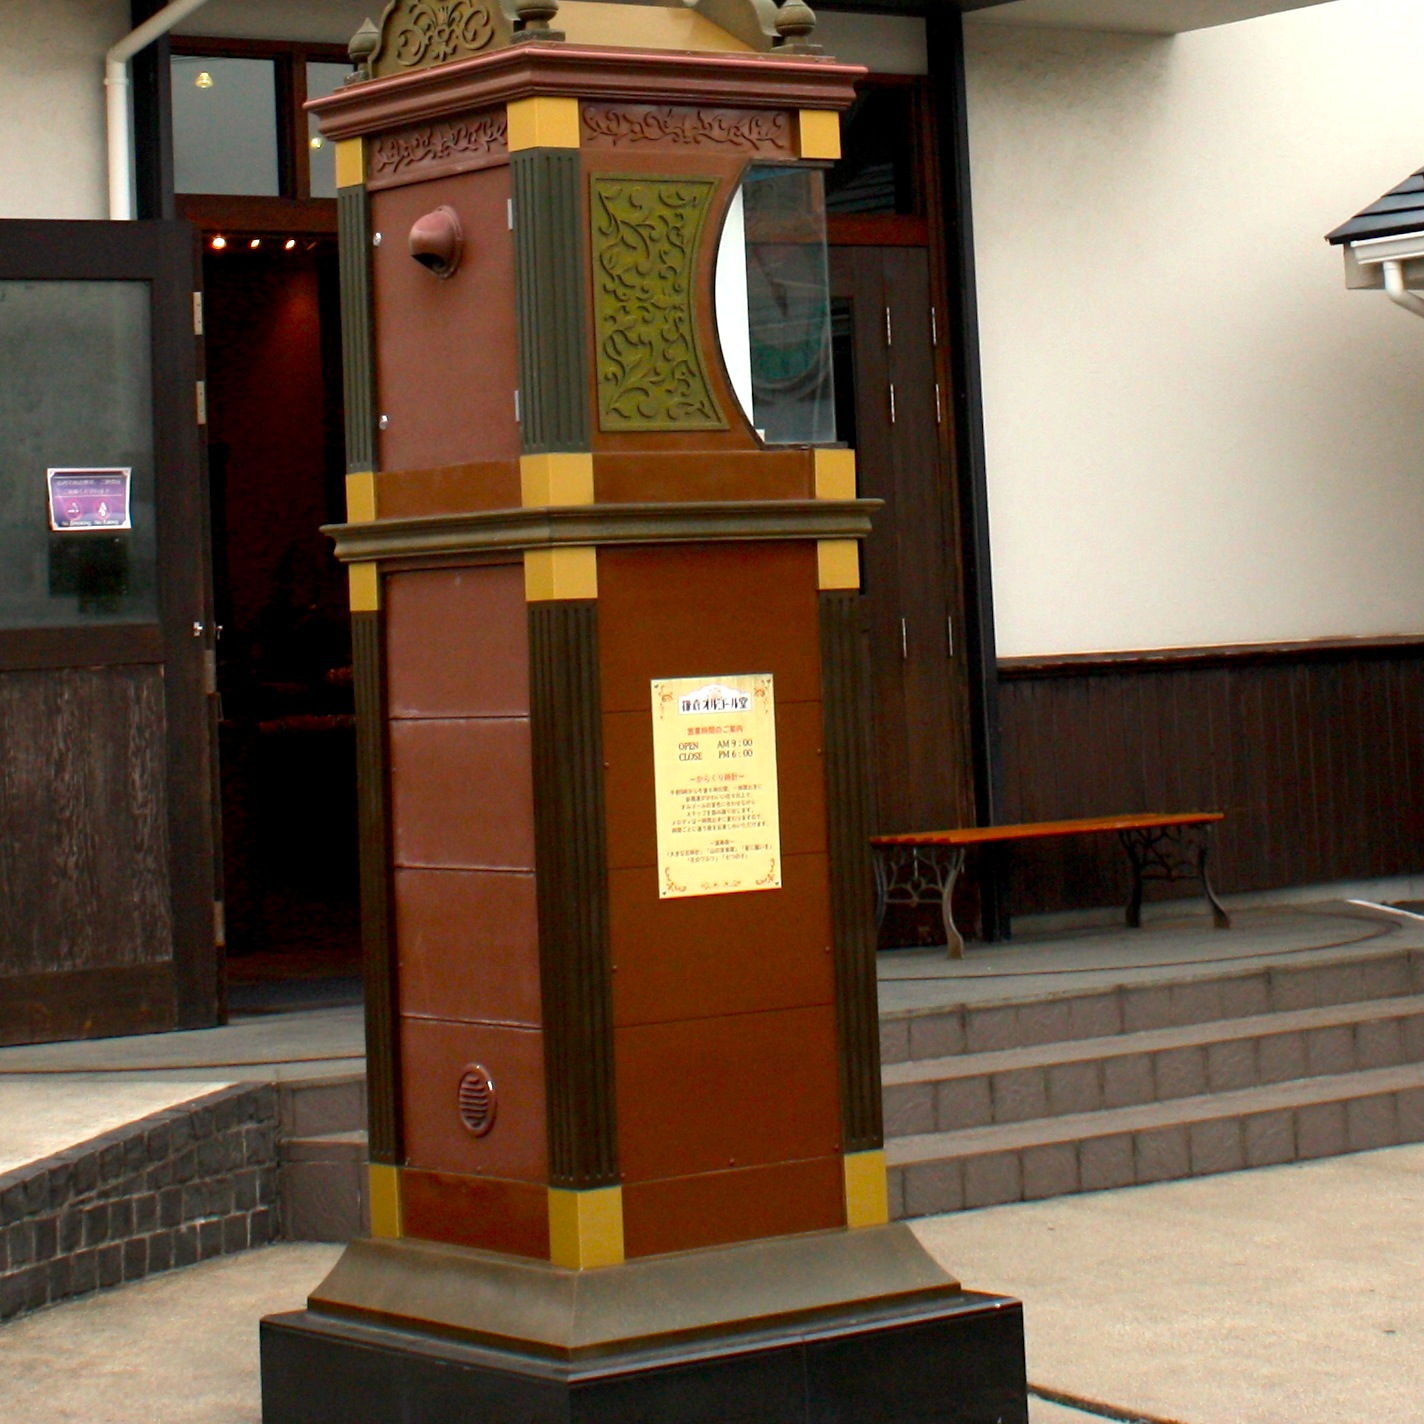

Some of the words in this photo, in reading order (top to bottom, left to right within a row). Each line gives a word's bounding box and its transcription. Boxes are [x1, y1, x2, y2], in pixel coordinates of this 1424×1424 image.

[678, 741, 699, 751] OPEN
[717, 739, 730, 749] AM
[678, 751, 703, 762] CLOSE
[718, 749, 730, 759] PM
